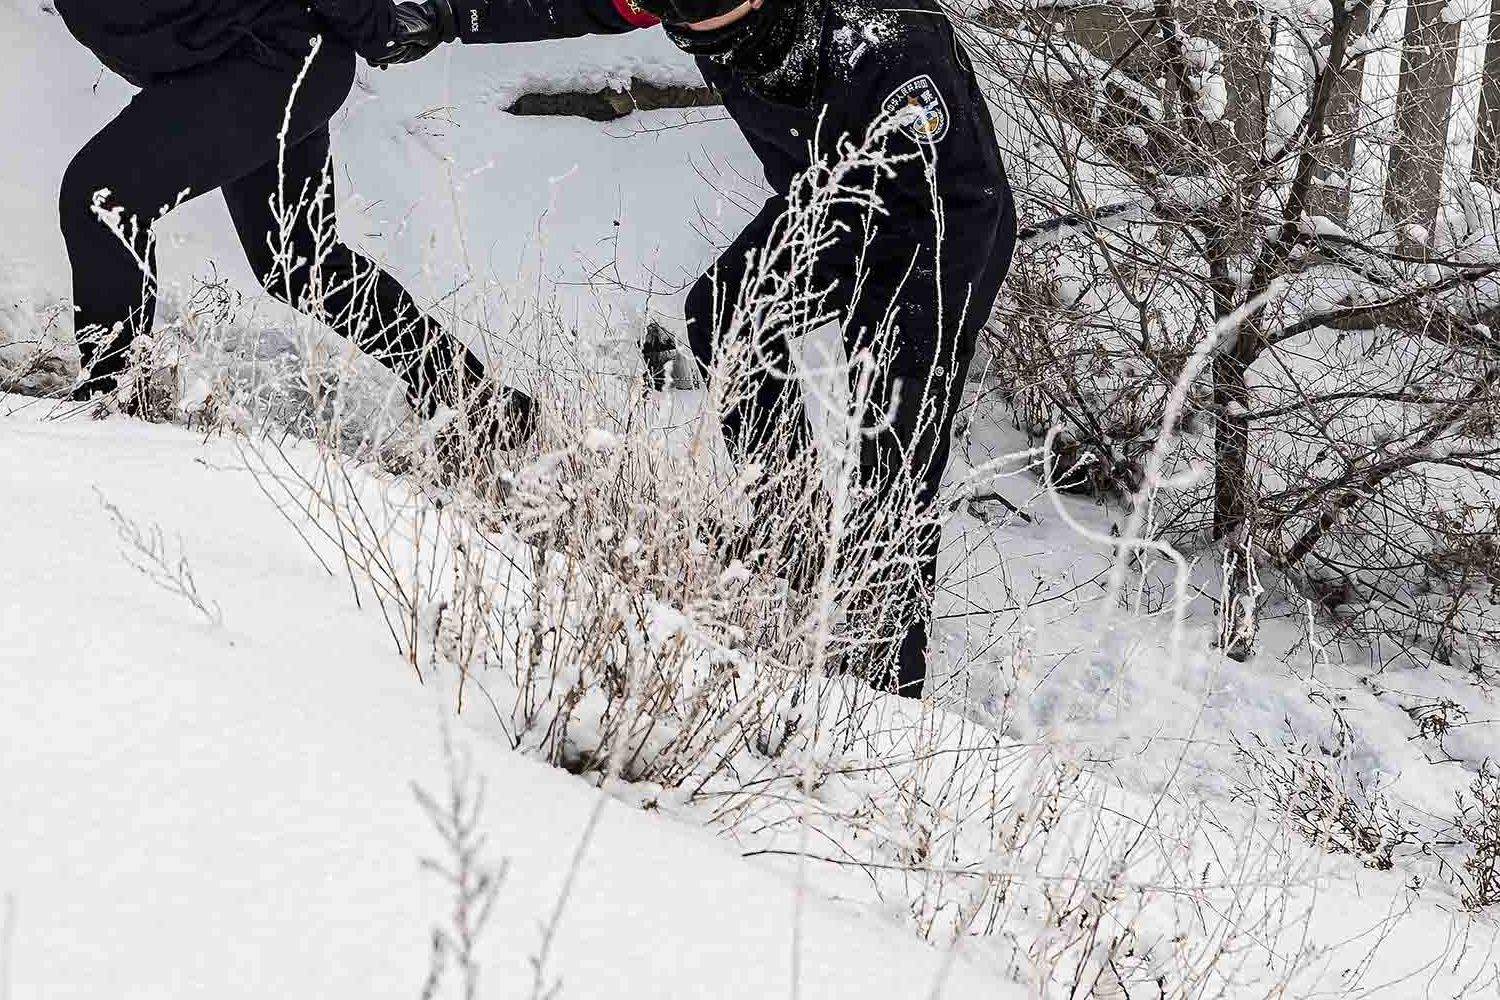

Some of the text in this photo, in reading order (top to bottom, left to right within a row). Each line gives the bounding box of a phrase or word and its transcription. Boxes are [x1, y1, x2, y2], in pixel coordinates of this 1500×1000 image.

[470, 9, 479, 32] POLICE
[887, 79, 928, 112] 中华人民共和国
